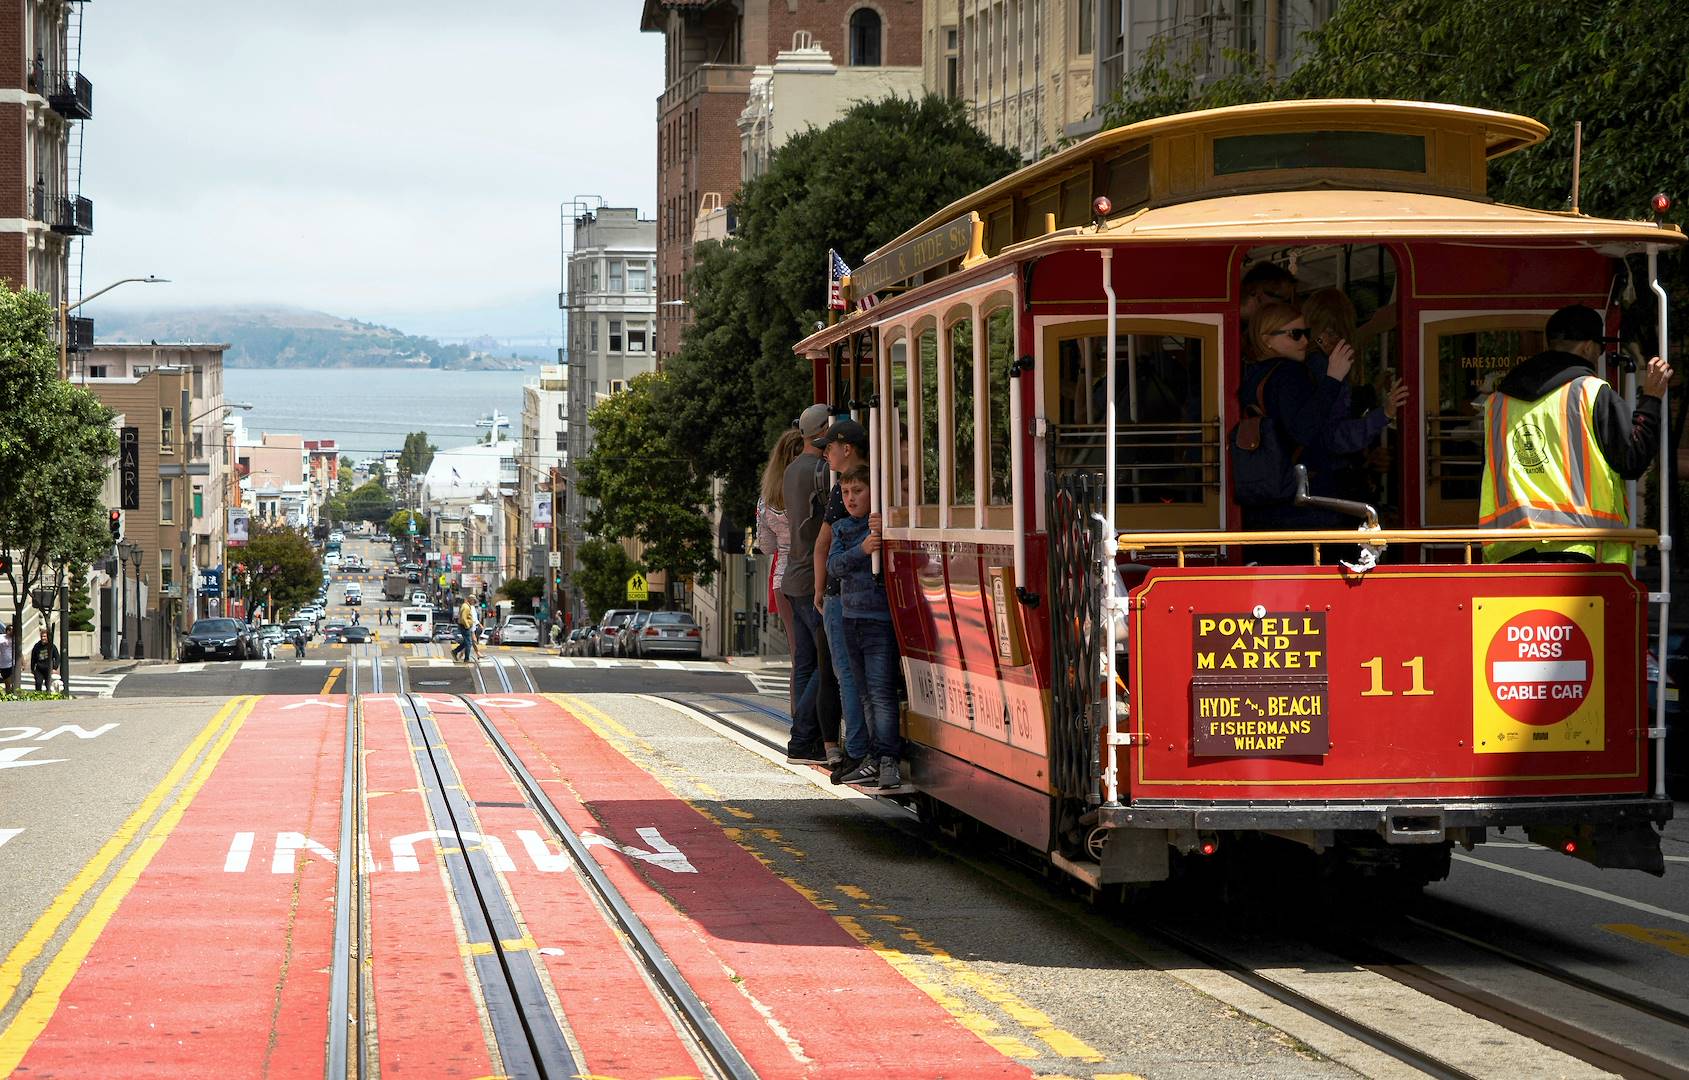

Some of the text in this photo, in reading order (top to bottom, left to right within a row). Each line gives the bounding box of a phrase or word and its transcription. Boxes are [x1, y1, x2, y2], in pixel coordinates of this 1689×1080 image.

[855, 261, 891, 292] POWELL
[898, 252, 907, 274] &
[913, 233, 945, 267] HYDE
[1461, 357, 1484, 368] FARE
[1485, 356, 1510, 368] $7.00
[124, 432, 135, 506] PARK
[1199, 617, 1320, 636] POWELL
[1507, 625, 1574, 643] DO NOT
[1231, 636, 1291, 650] AND
[1518, 642, 1563, 659] PASS
[1196, 651, 1322, 669] MARKET
[1360, 656, 1435, 697] 11
[1496, 685, 1584, 701] CABLE CAR
[1199, 696, 1322, 718] HYDE AND BEACH
[1209, 720, 1312, 736] FISHERMANS
[1233, 736, 1287, 750] WHARF
[223, 827, 699, 874] MUNI
